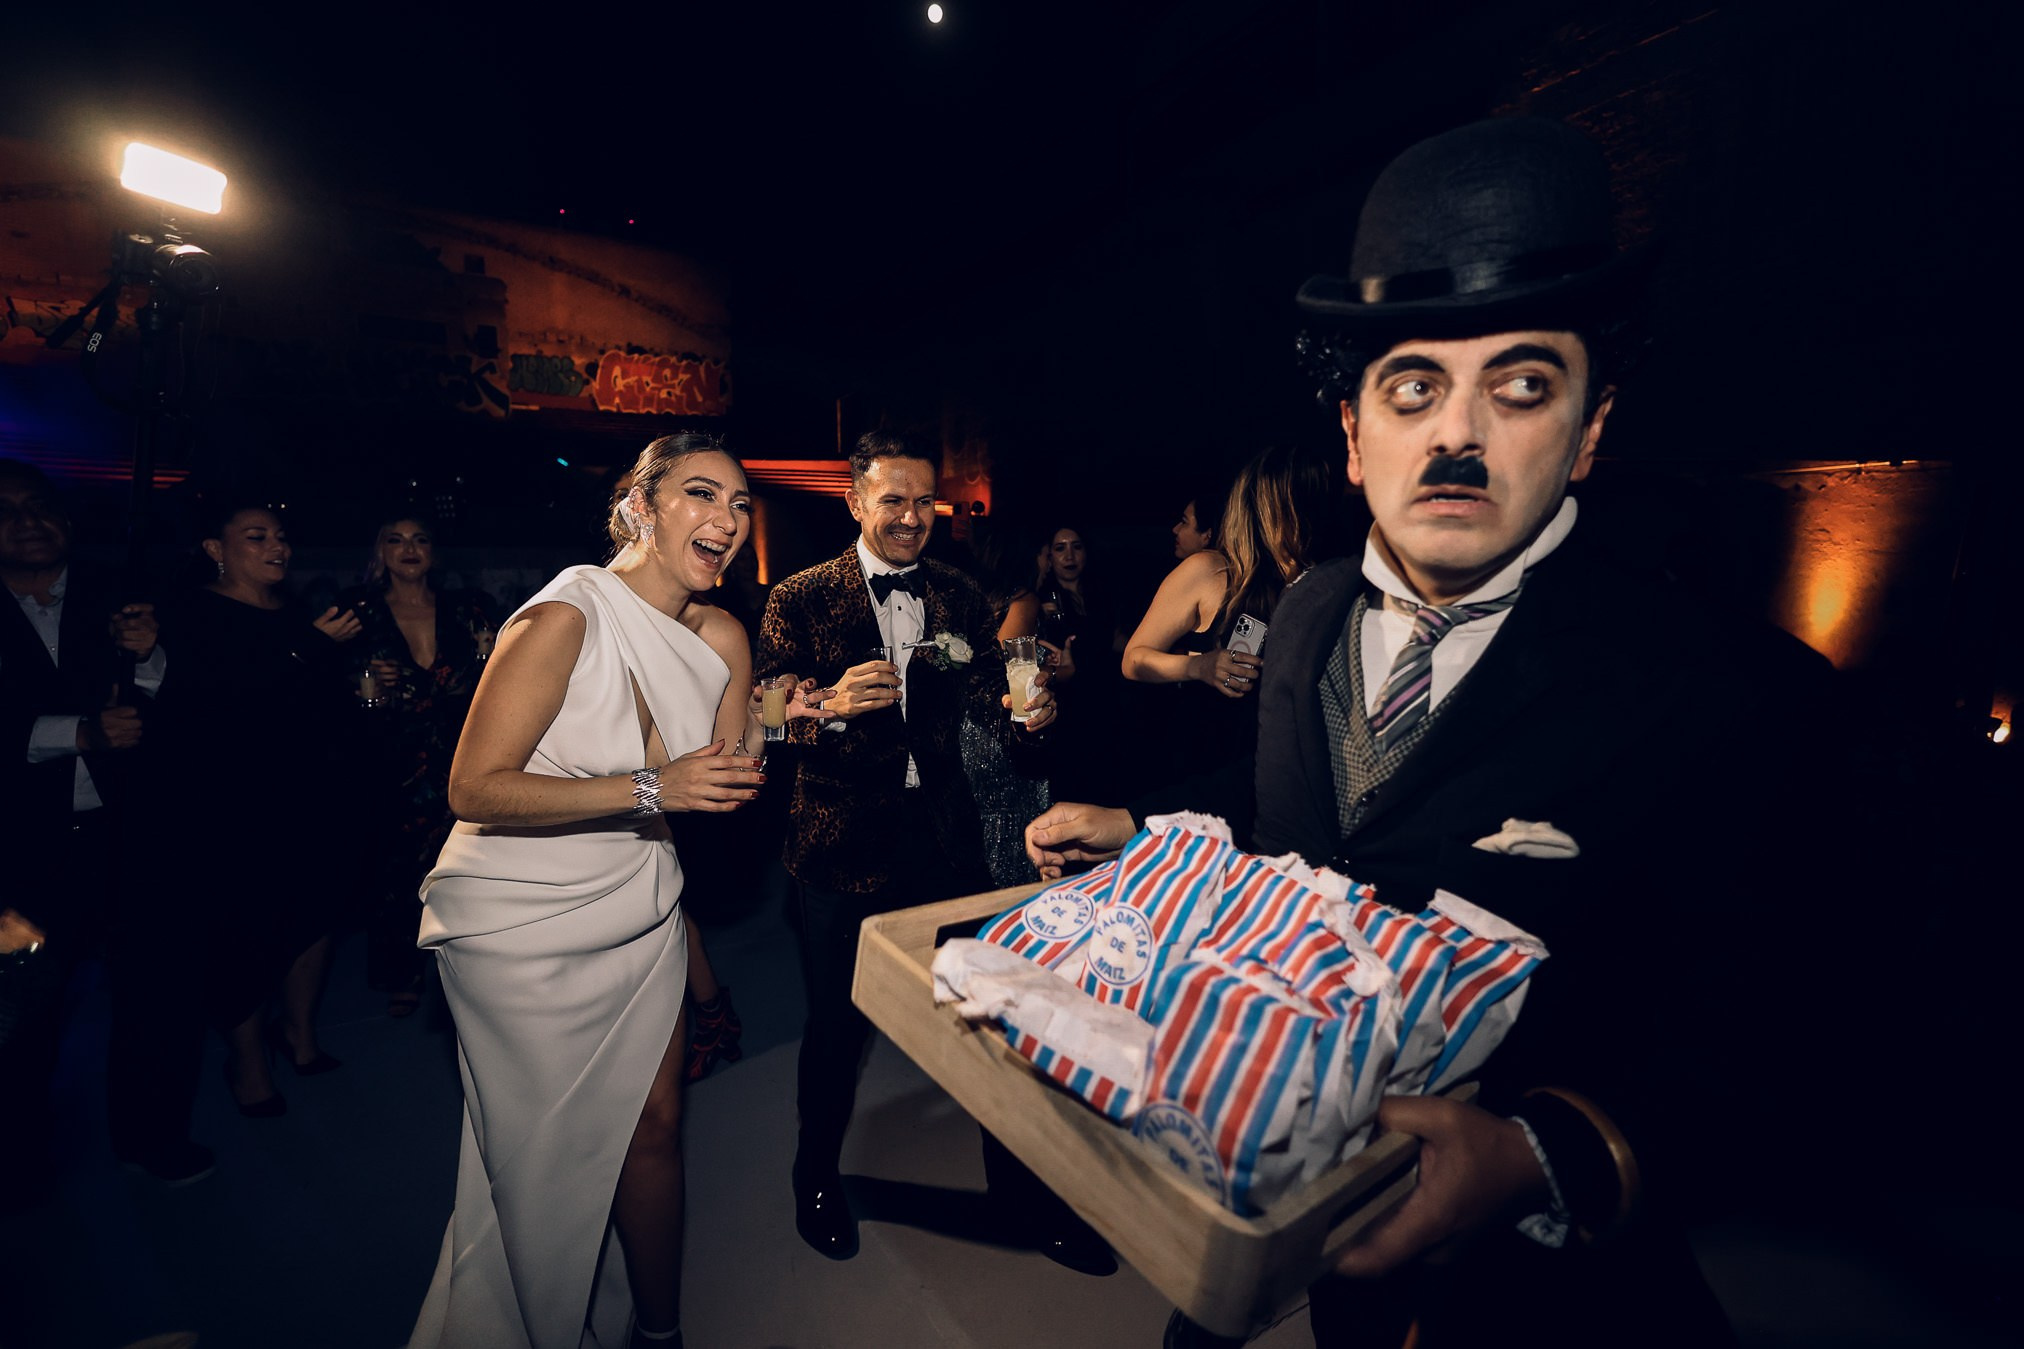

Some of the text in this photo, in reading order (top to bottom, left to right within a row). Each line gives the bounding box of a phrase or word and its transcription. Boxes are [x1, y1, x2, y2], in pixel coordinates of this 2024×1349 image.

[87, 332, 102, 352] EOS
[1051, 906, 1067, 918] DE
[1031, 915, 1057, 936] MAIZ
[1110, 936, 1127, 954] DE
[1094, 956, 1125, 980] MAIZ
